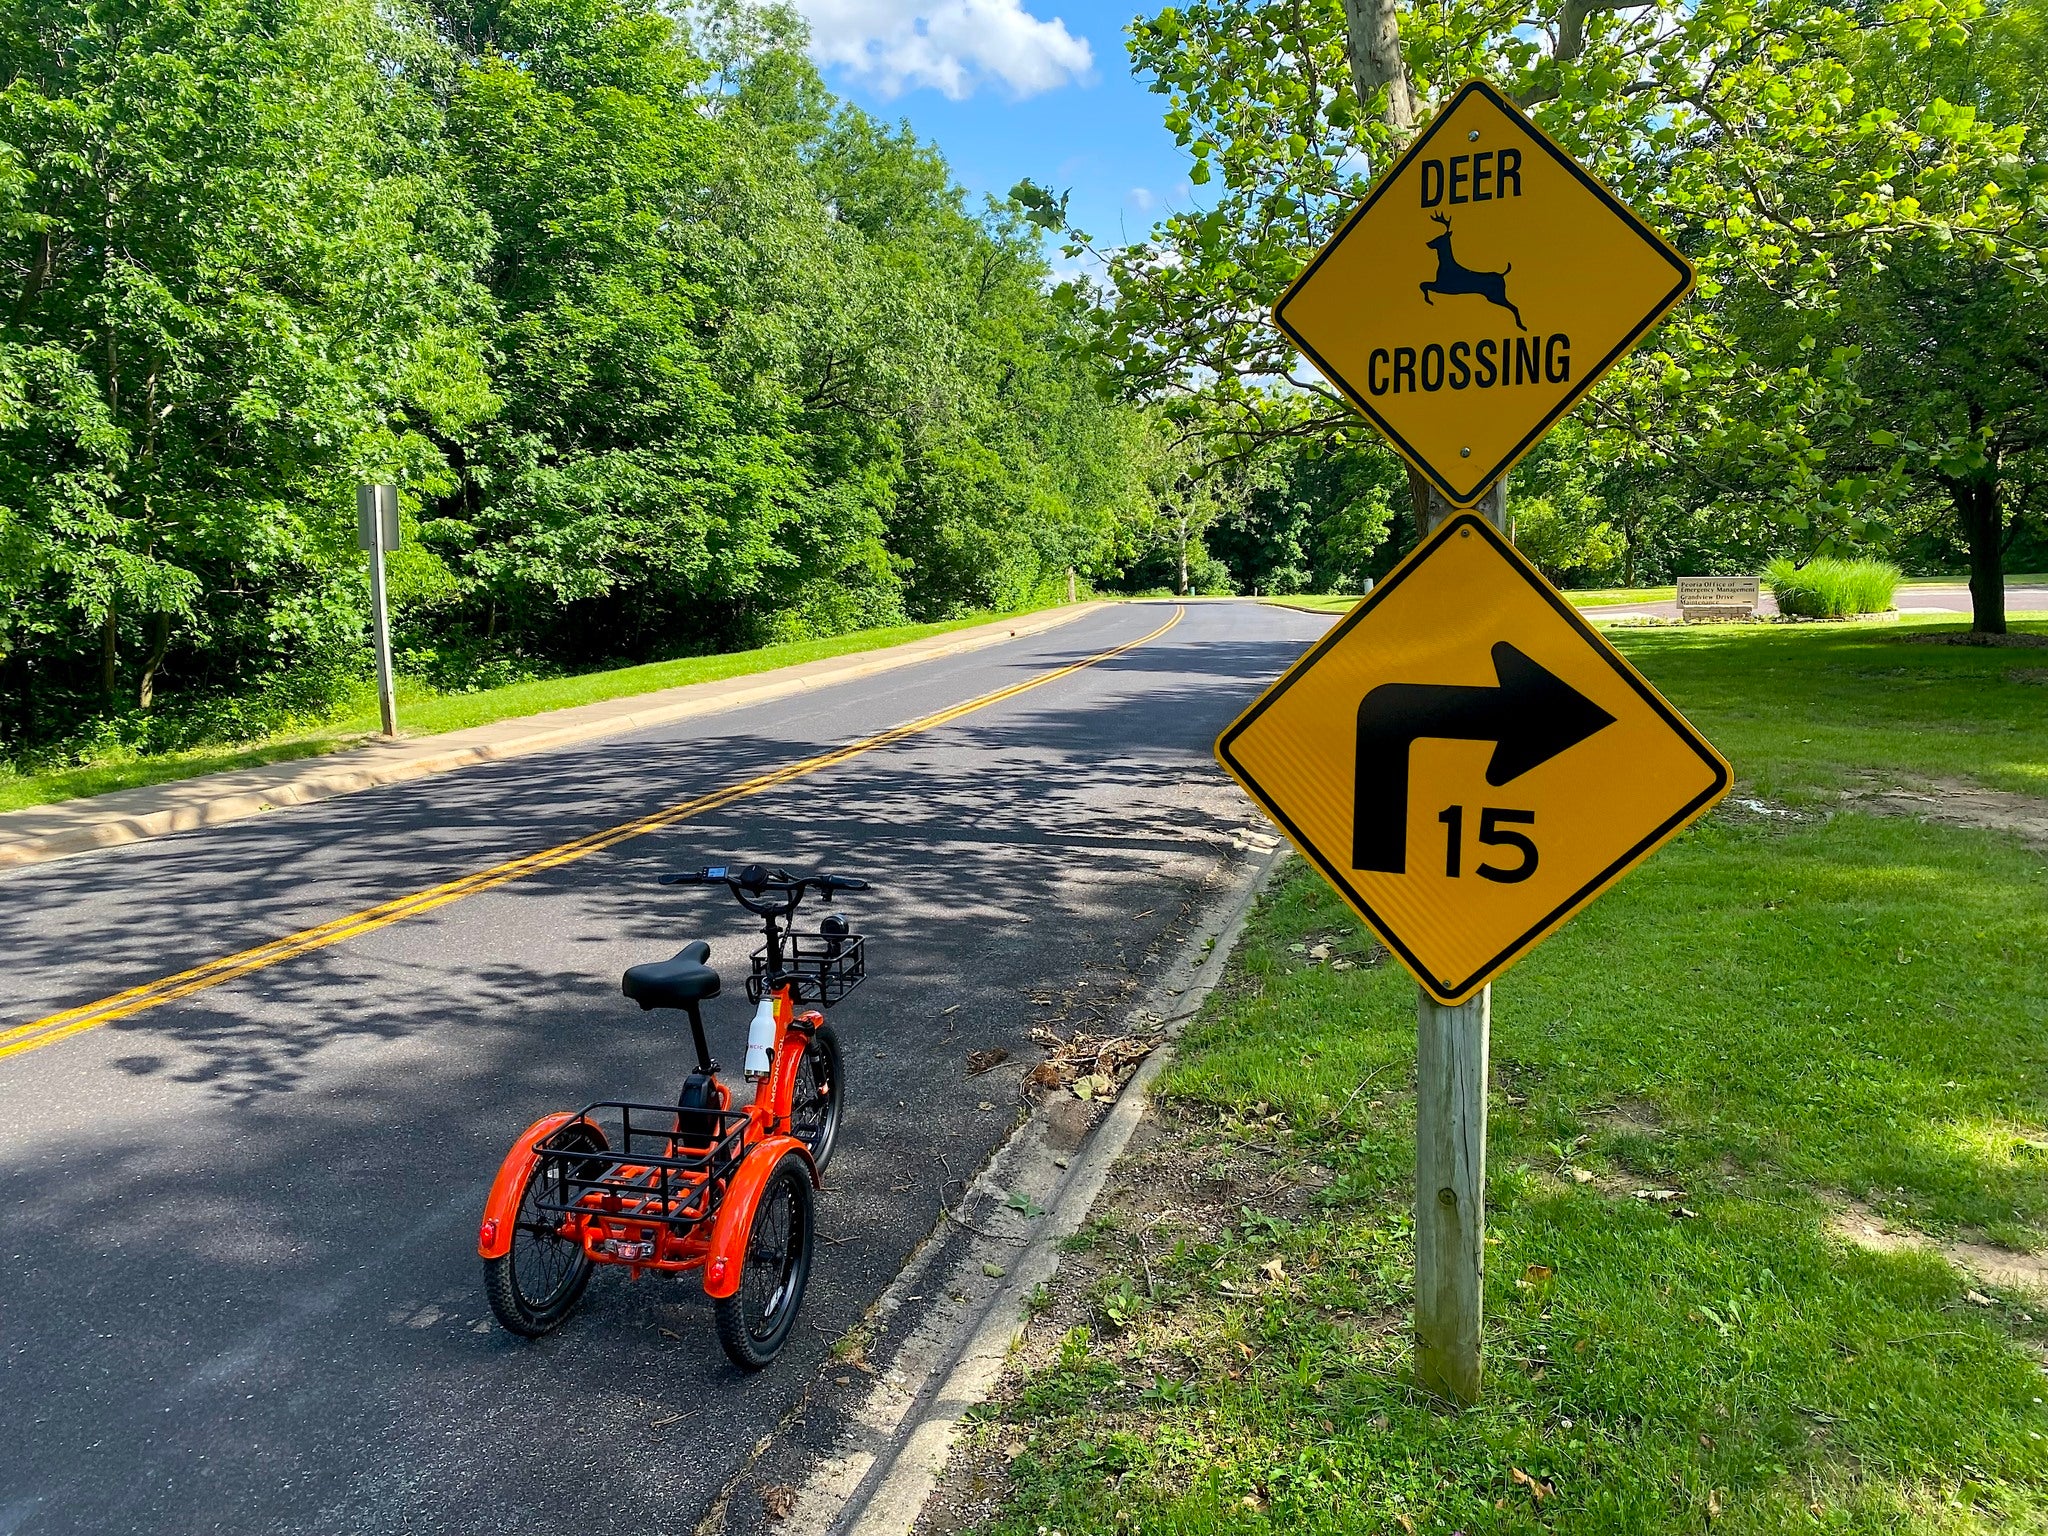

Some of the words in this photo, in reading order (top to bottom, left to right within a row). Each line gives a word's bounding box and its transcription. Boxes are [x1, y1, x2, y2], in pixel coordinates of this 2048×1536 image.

[1421, 148, 1522, 209] DEER
[1368, 333, 1571, 396] CROSSING
[1438, 805, 1539, 884] 15
